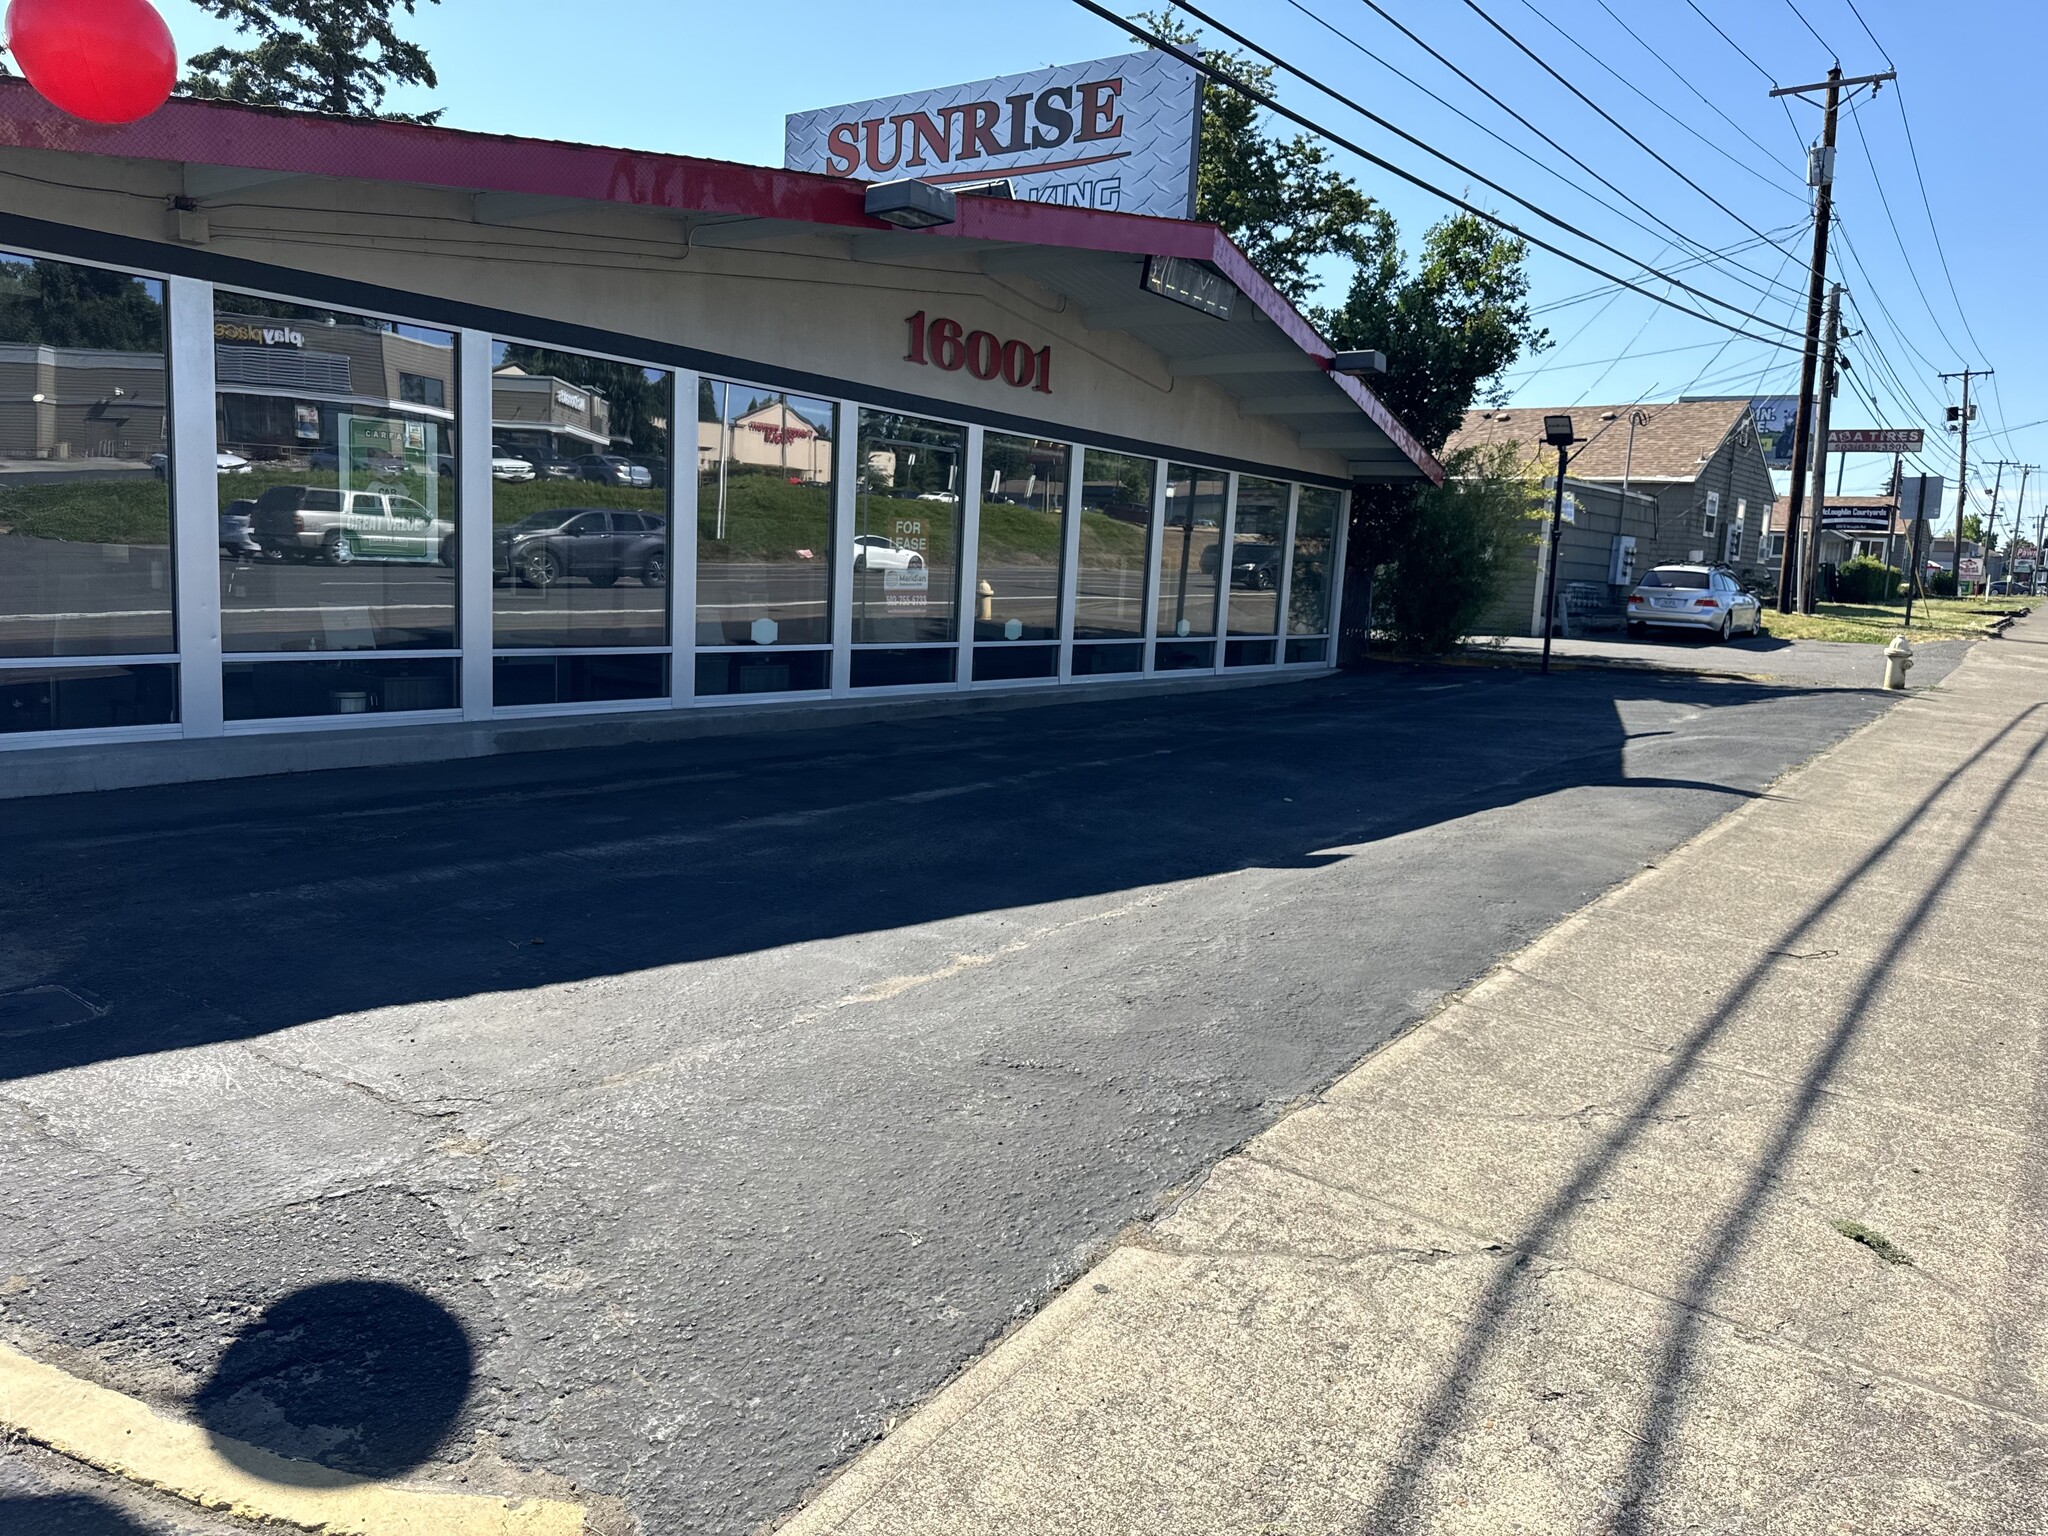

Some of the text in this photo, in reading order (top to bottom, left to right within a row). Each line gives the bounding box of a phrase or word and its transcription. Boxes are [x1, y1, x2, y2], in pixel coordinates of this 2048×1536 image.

[826, 77, 1123, 177] SUNRISE
[903, 310, 1052, 394] 16001
[1869, 431, 1920, 442] TIRES
[895, 520, 921, 534] FOR
